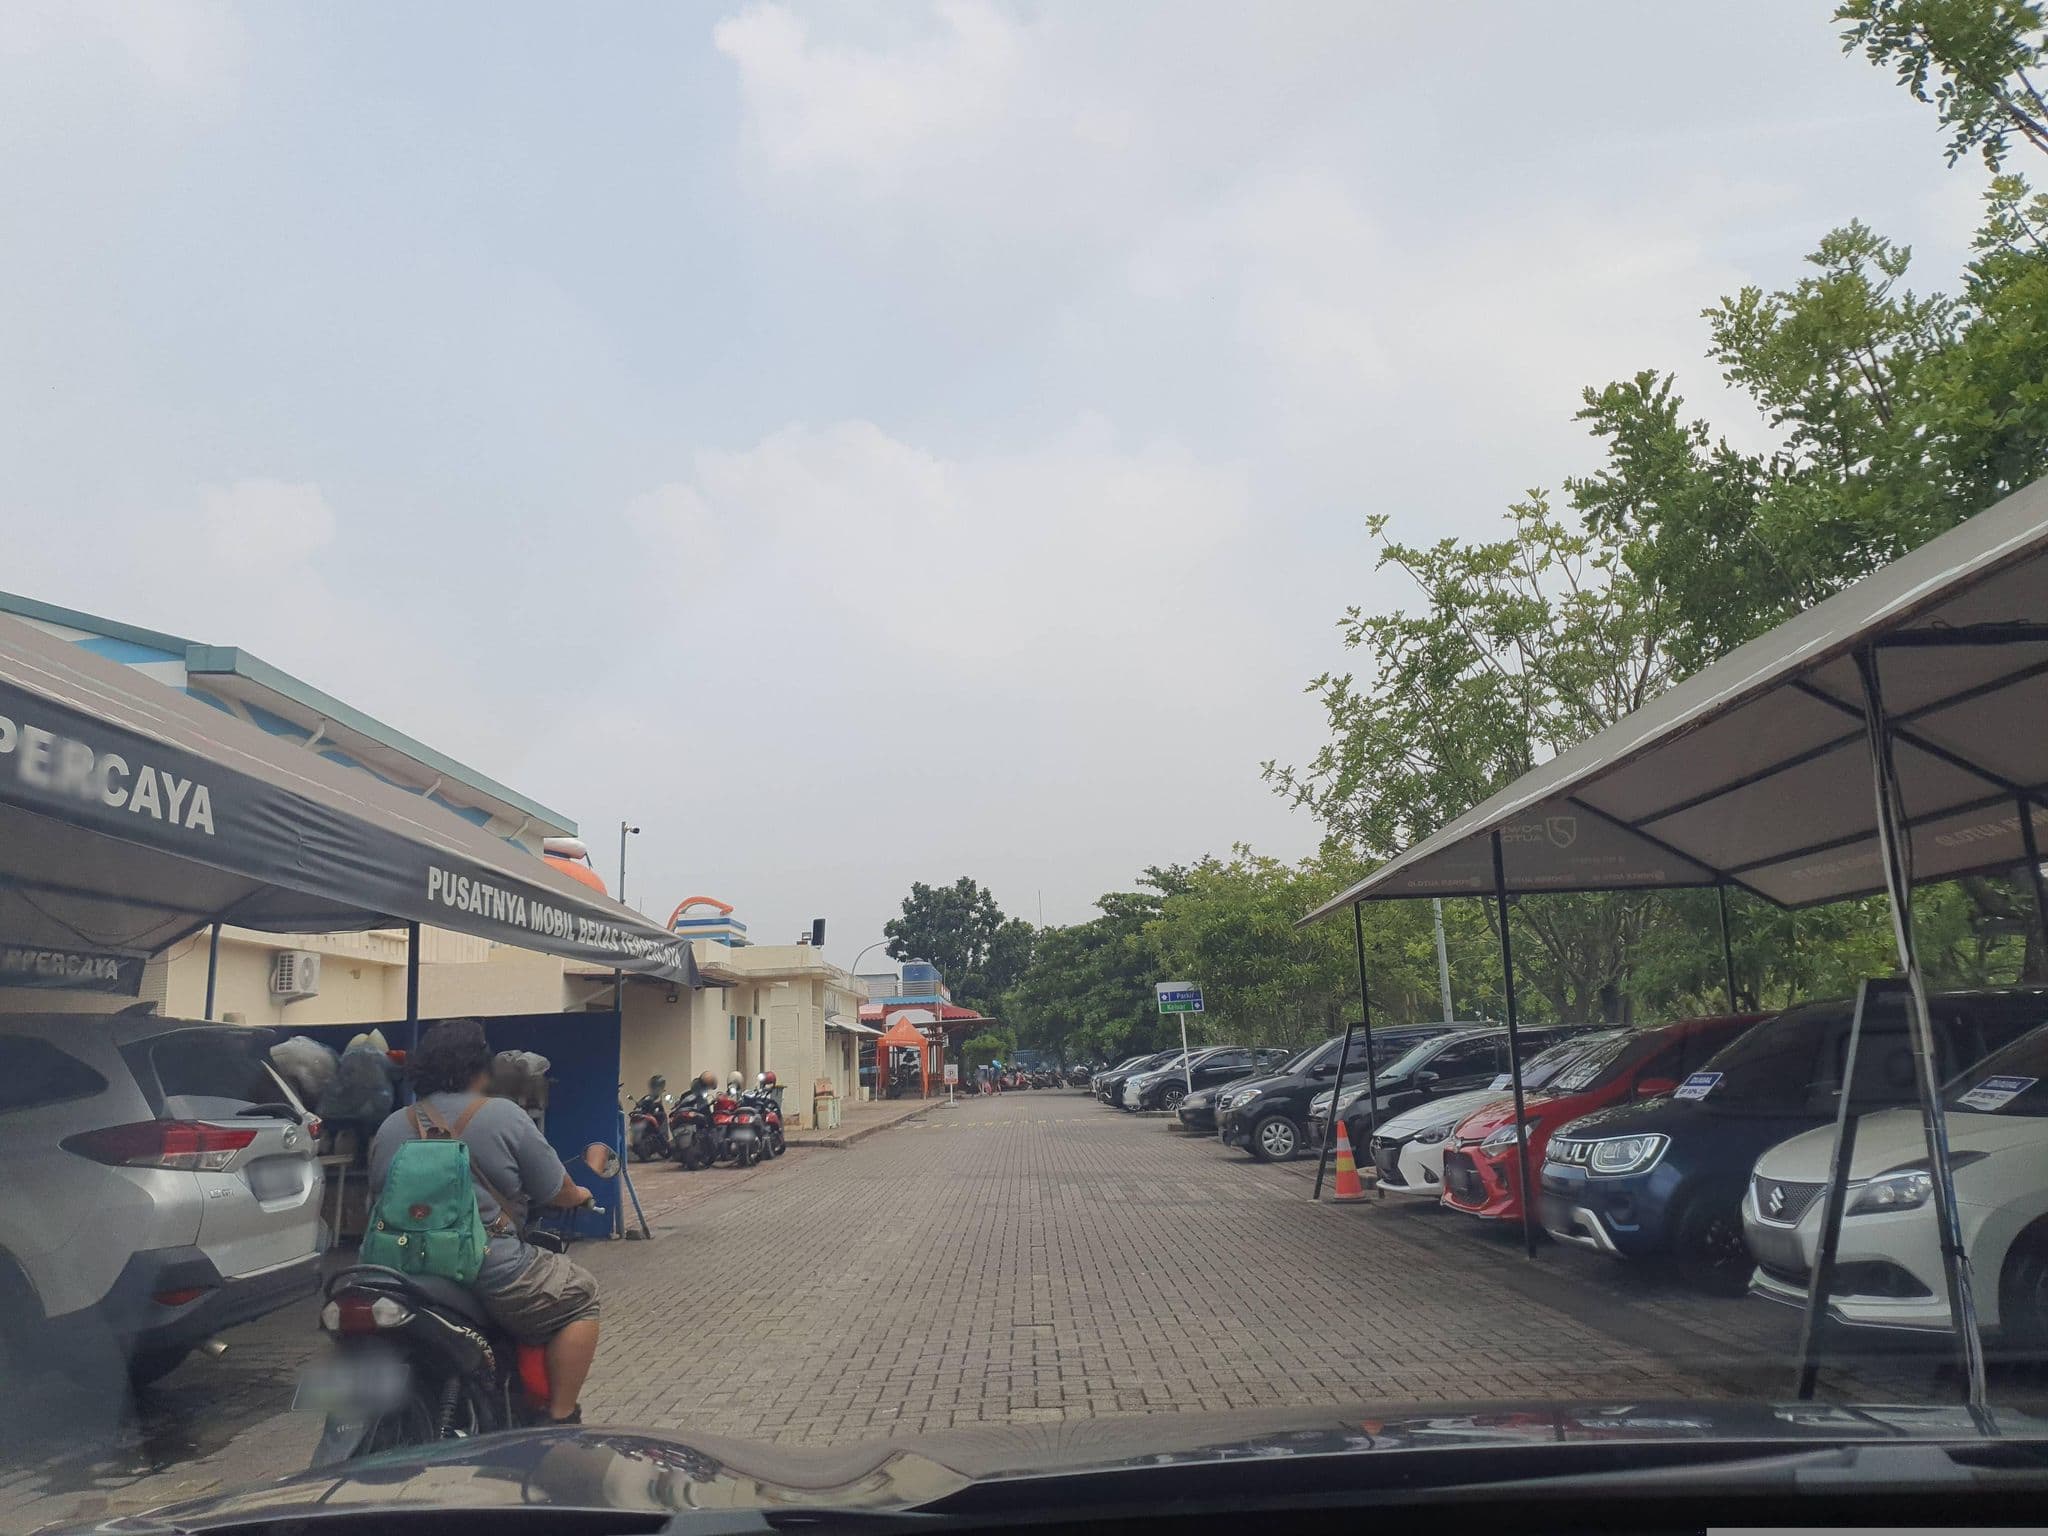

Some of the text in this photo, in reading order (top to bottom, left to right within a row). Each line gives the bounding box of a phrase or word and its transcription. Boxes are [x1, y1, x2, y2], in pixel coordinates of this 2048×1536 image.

[427, 866, 526, 928] PUSATNYA
[531, 901, 575, 942] MOBIL
[578, 917, 619, 952] BEKAS
